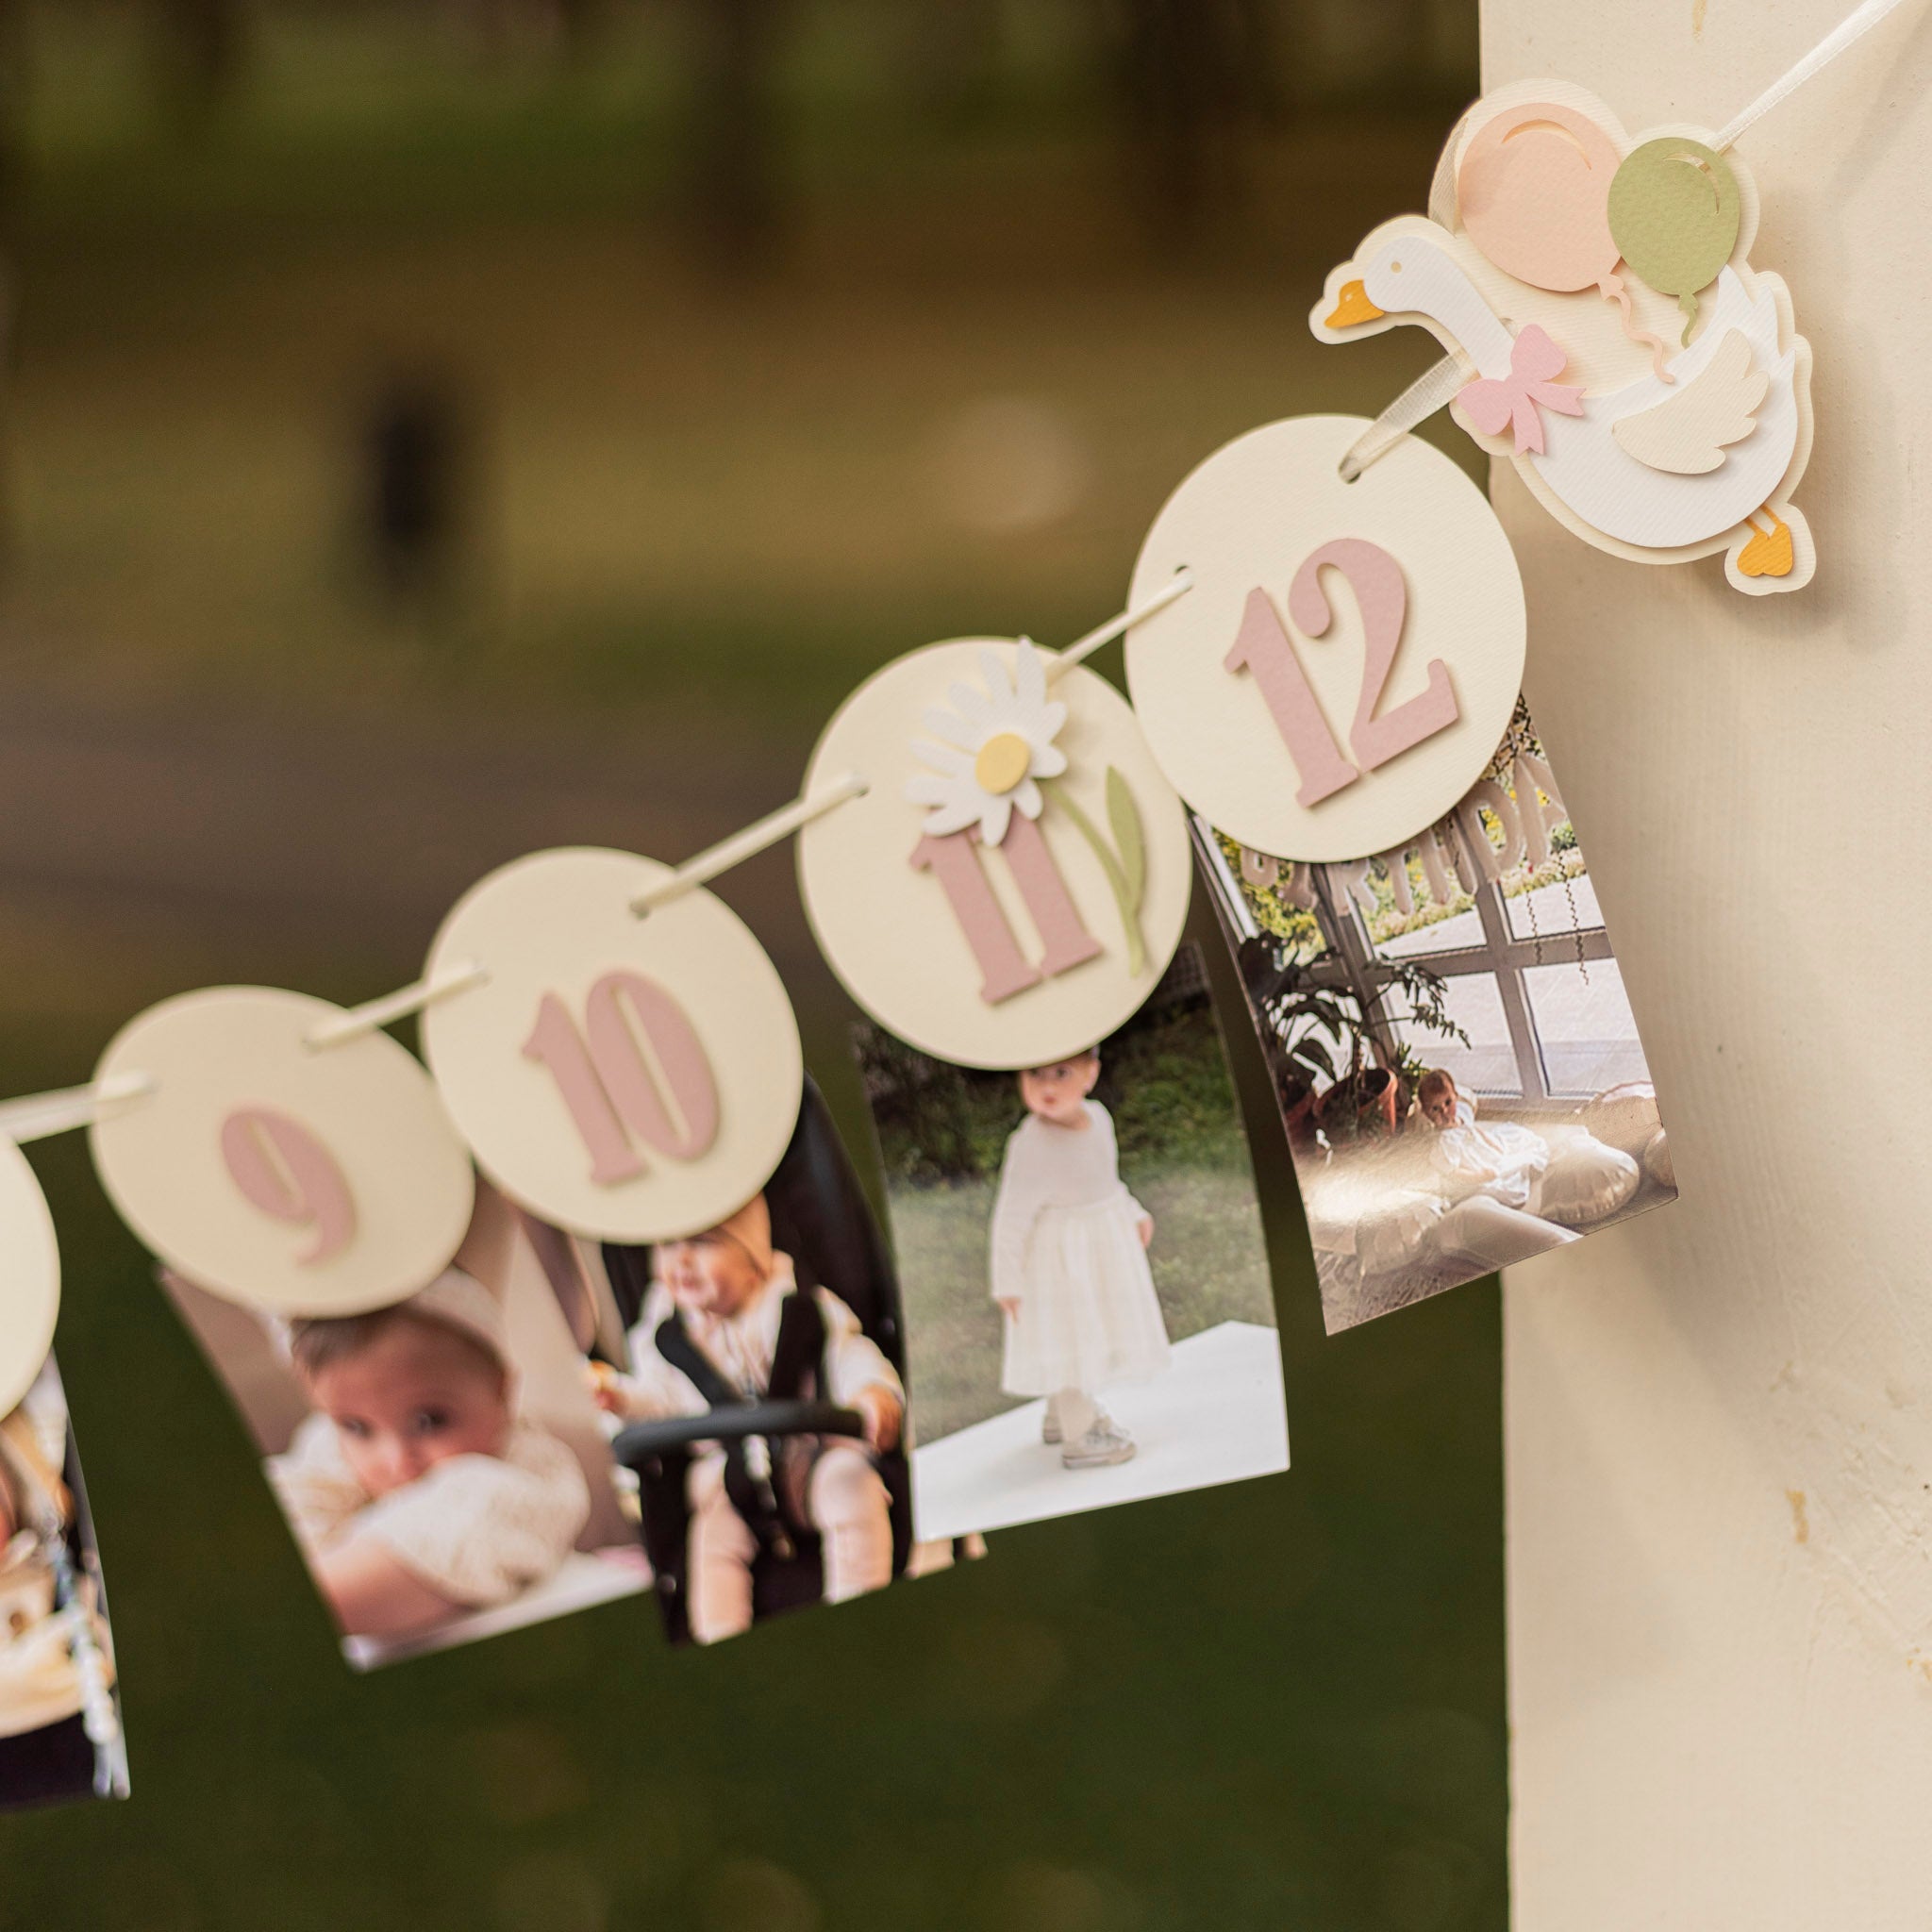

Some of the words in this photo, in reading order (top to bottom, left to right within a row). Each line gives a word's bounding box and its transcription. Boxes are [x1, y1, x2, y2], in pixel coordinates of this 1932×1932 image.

[1224, 538, 1459, 809] 12
[909, 805, 1104, 1006] 11
[522, 969, 722, 1186] 10
[220, 1104, 357, 1266] 9
